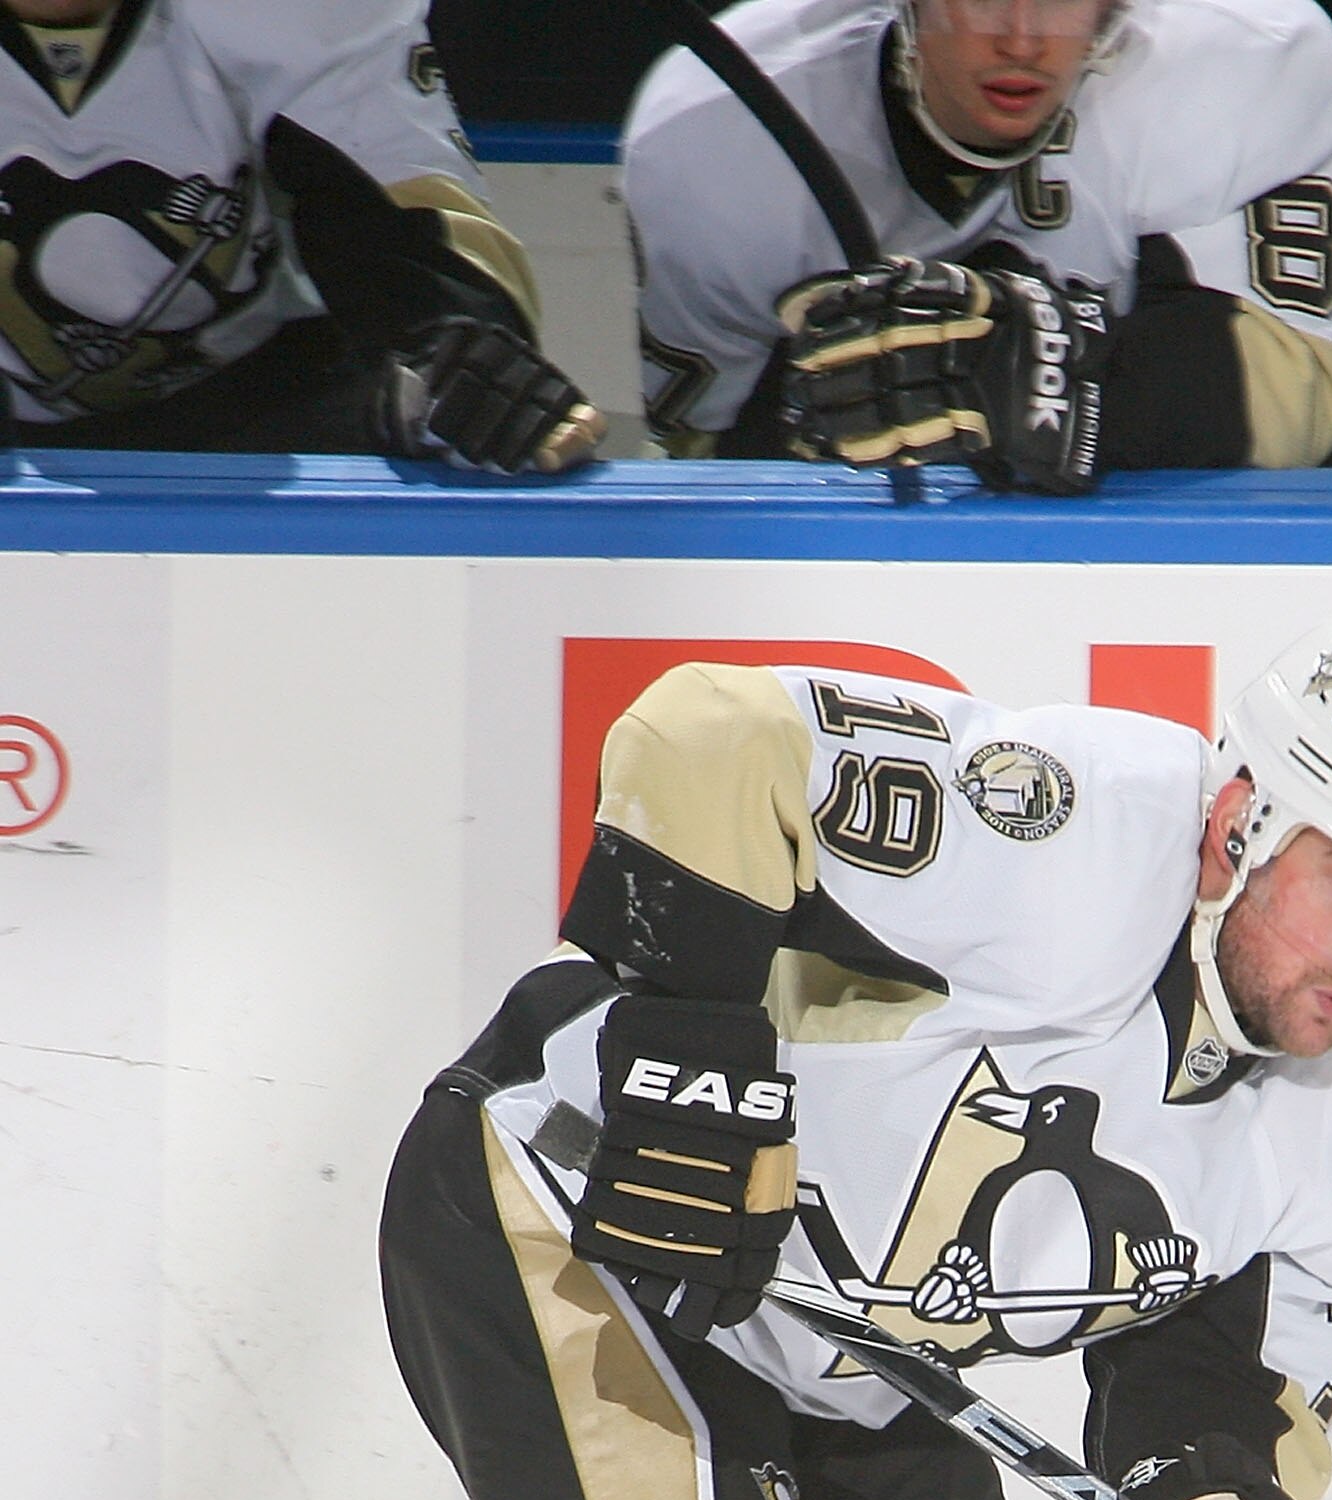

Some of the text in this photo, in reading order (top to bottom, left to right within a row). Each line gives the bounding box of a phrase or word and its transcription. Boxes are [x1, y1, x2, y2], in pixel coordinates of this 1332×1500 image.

[1008, 272, 1072, 432] eebok
[807, 678, 951, 879] 19
[620, 1057, 797, 1122] EAS
